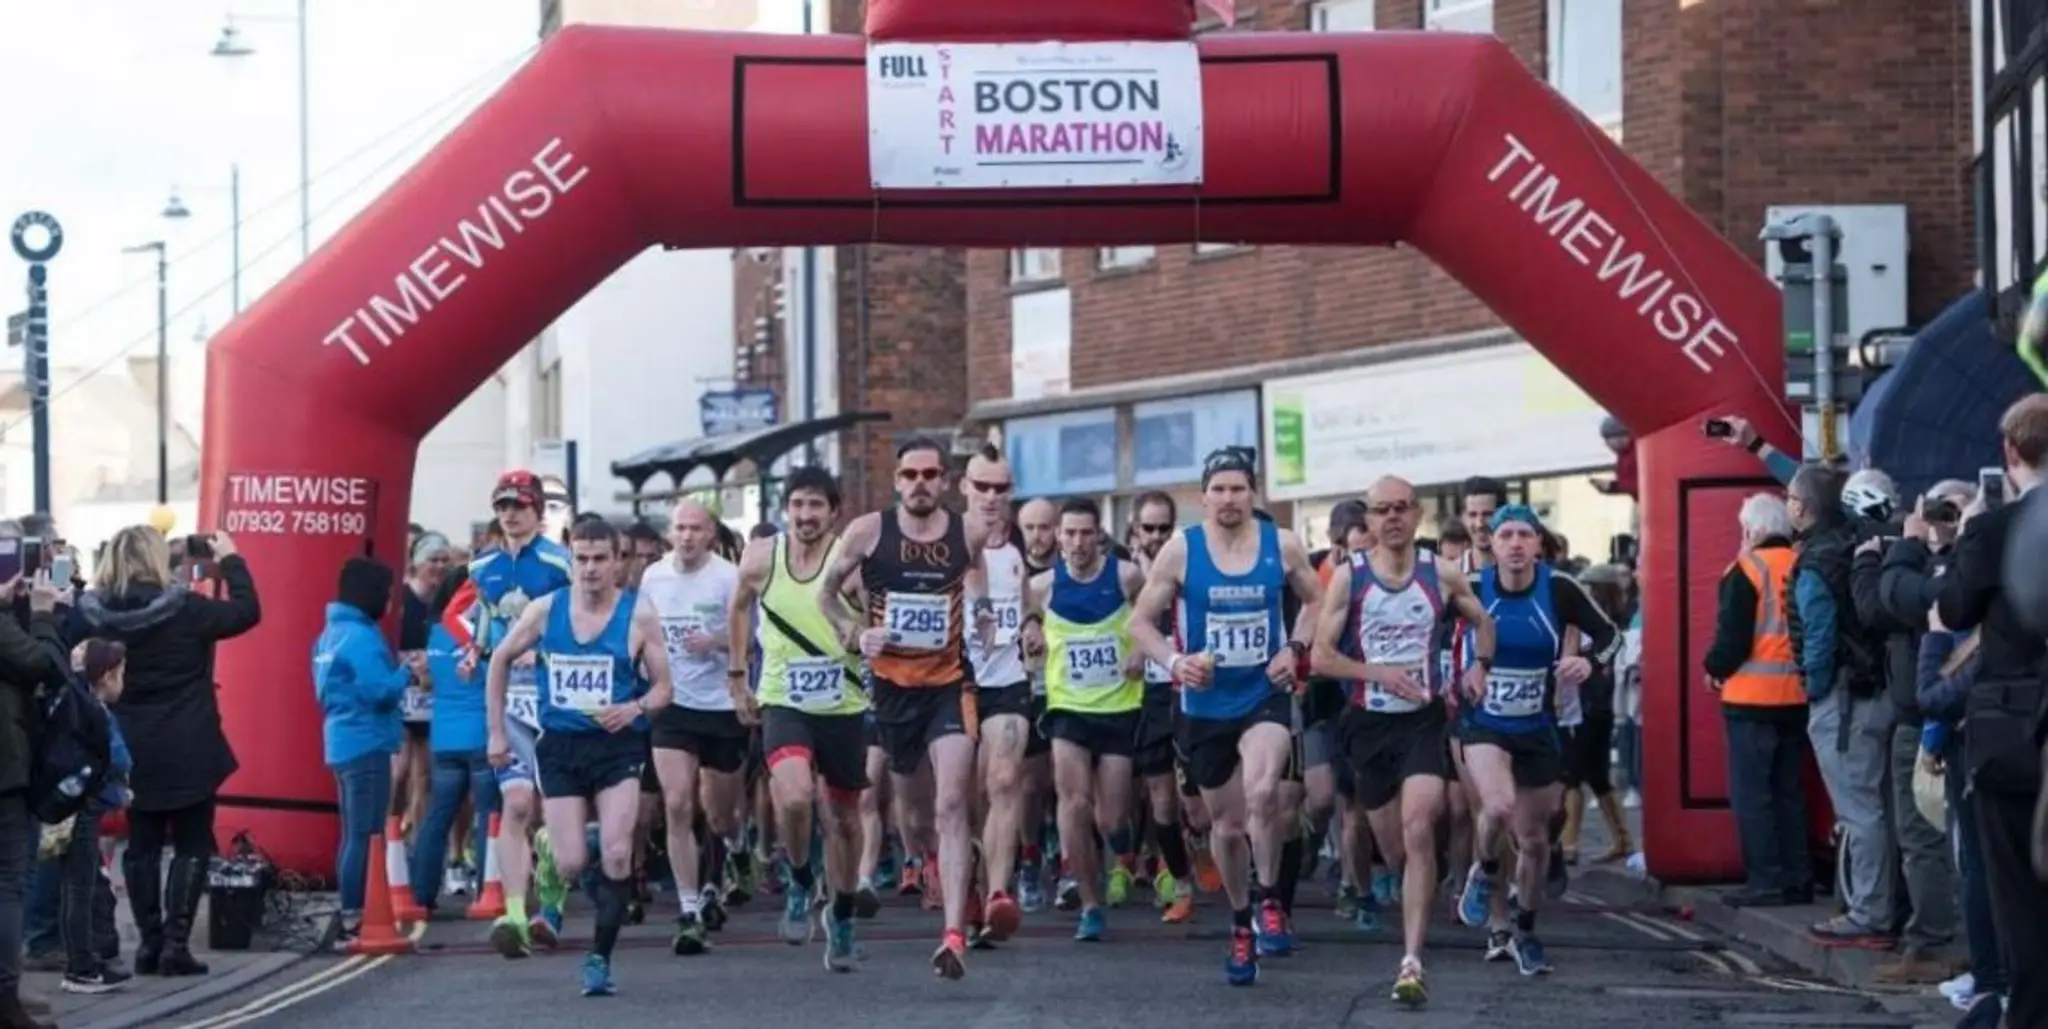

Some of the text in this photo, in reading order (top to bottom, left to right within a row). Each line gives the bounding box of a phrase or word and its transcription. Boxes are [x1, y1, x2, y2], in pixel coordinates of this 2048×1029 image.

[879, 56, 927, 77] FULL
[938, 50, 955, 155] START
[974, 79, 1159, 113] BOSTON
[976, 121, 1163, 154] MARATHON
[323, 137, 589, 365] TIMEWISE
[1487, 132, 1738, 373] TIMEWISE
[229, 477, 367, 504] TIMEWISE
[227, 512, 366, 534] 07932 758190
[889, 607, 945, 632] 1295
[1210, 626, 1268, 650] 1118
[1068, 645, 1118, 669] 1343
[553, 669, 609, 692] 1444
[788, 668, 841, 692] 1227
